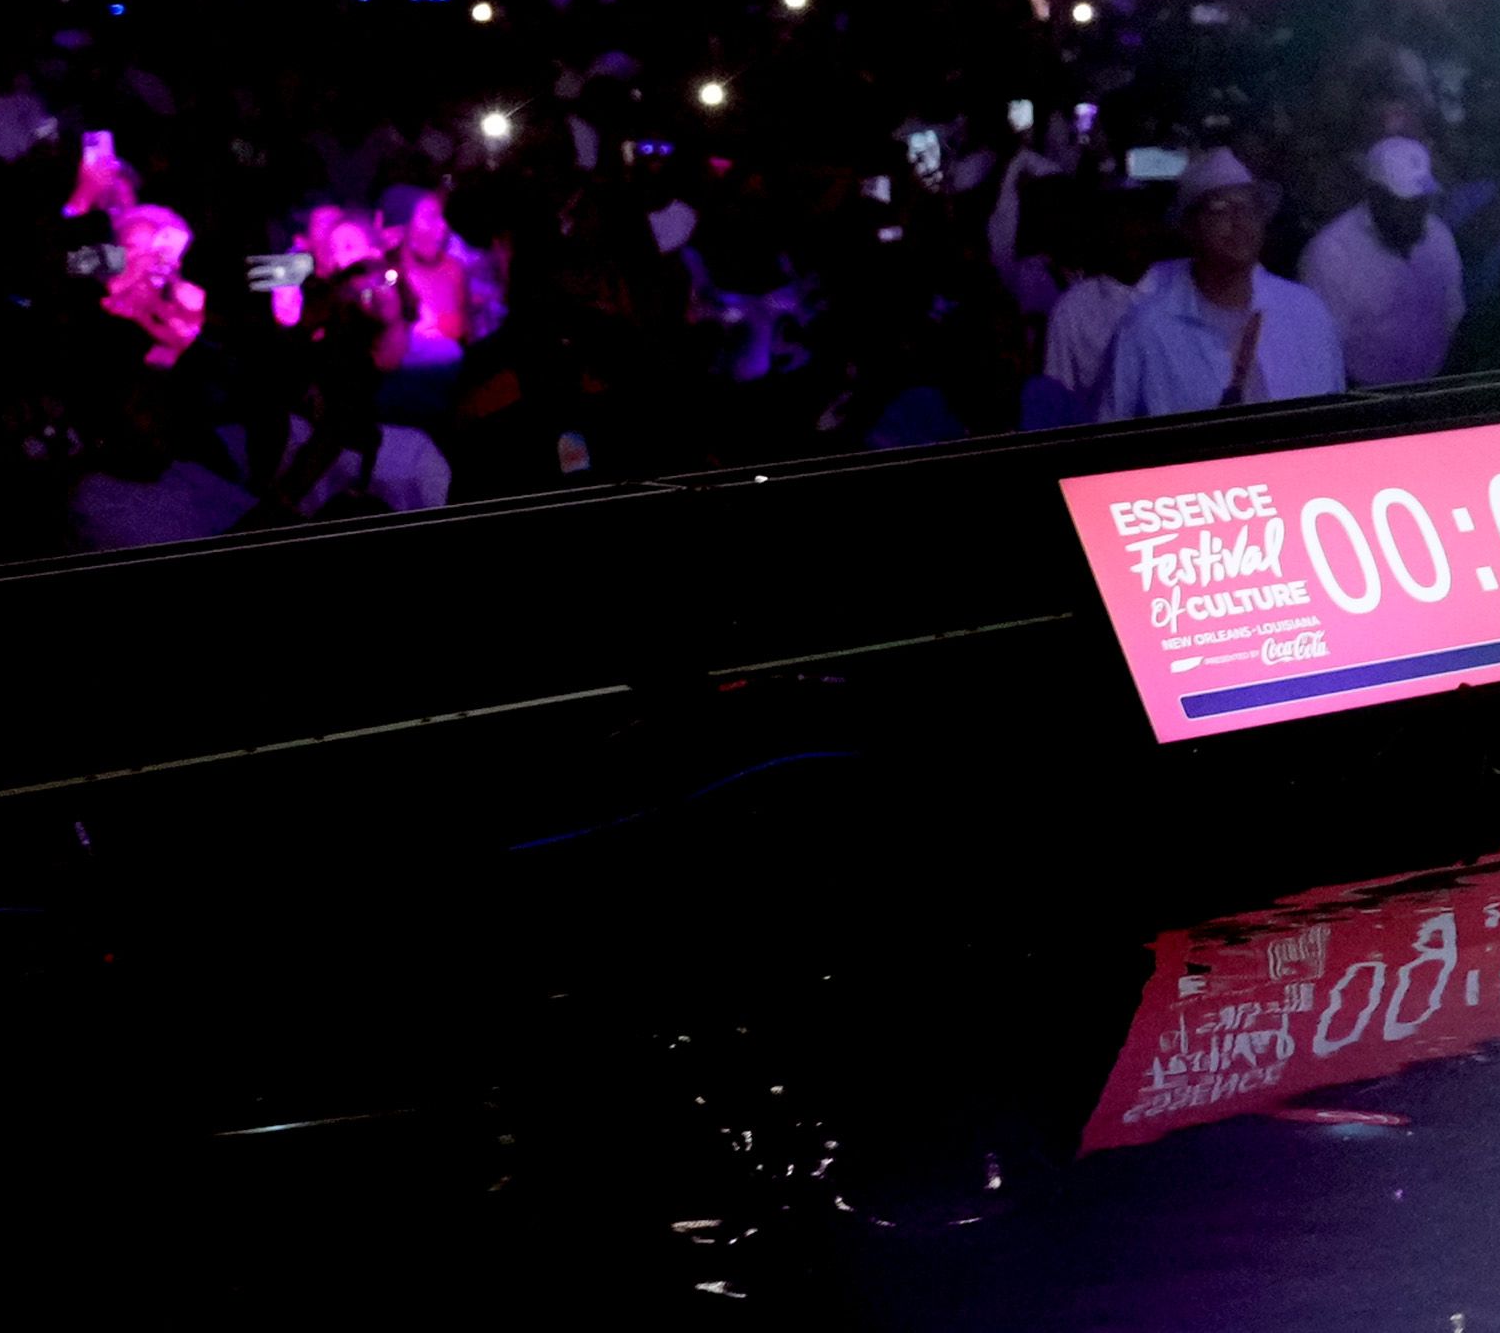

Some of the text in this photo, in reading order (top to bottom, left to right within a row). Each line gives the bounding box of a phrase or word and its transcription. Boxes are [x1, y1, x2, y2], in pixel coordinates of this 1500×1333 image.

[1109, 484, 1278, 536] ESSENCE
[1124, 517, 1285, 592] Festival
[1185, 580, 1311, 621] CULTURE
[1161, 636, 1192, 651] NEW
